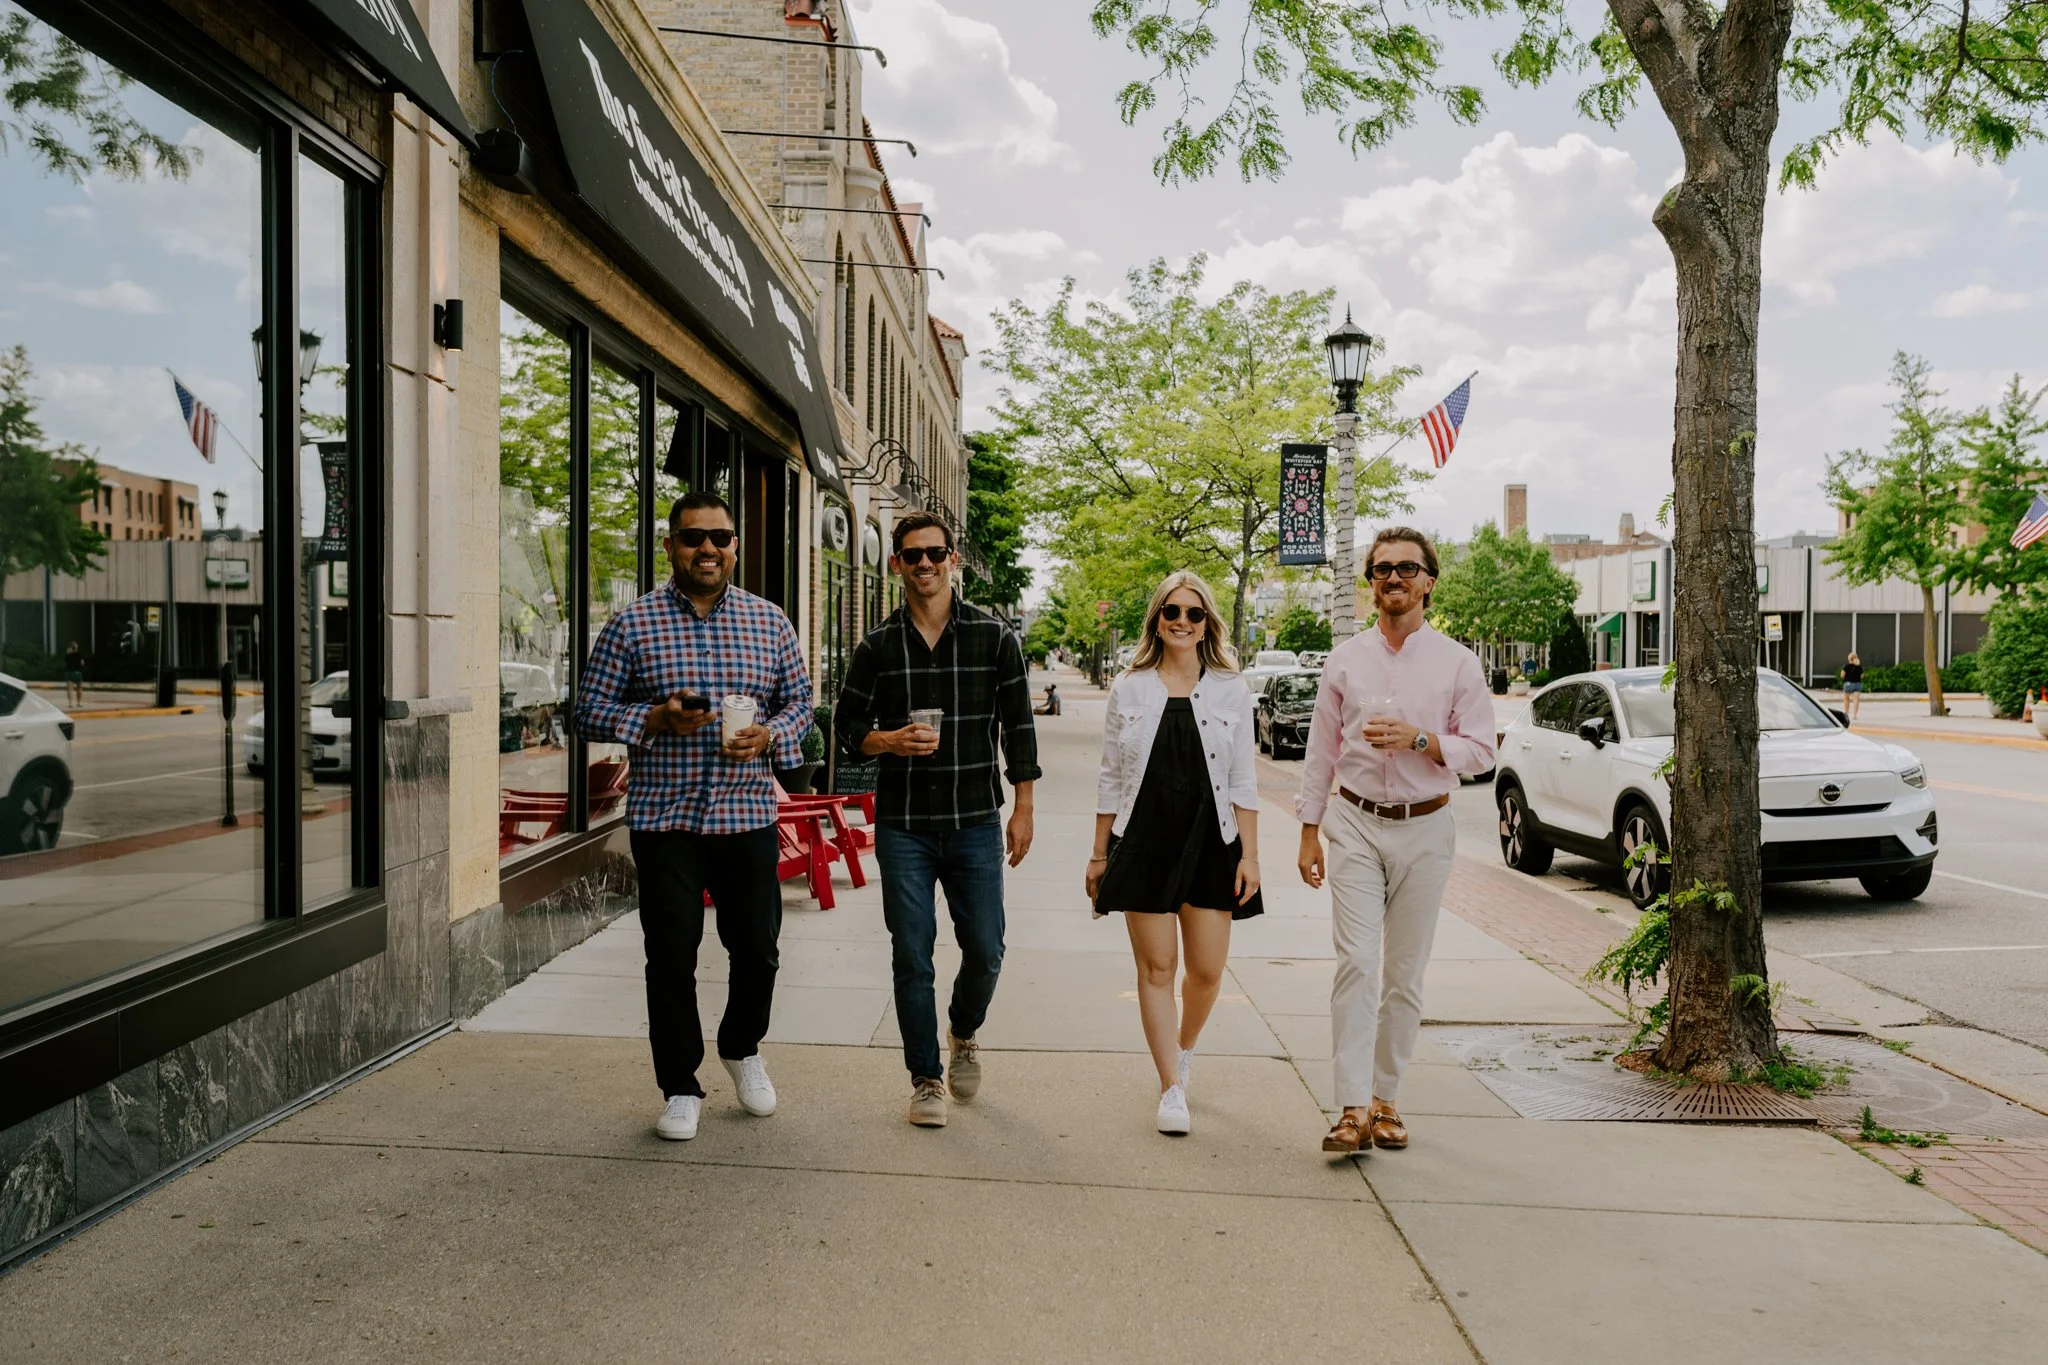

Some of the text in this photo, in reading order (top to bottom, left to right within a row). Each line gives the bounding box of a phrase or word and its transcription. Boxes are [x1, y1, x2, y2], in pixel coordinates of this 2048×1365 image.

[579, 37, 634, 149] The
[627, 103, 692, 220] Great
[682, 175, 736, 275] Frame
